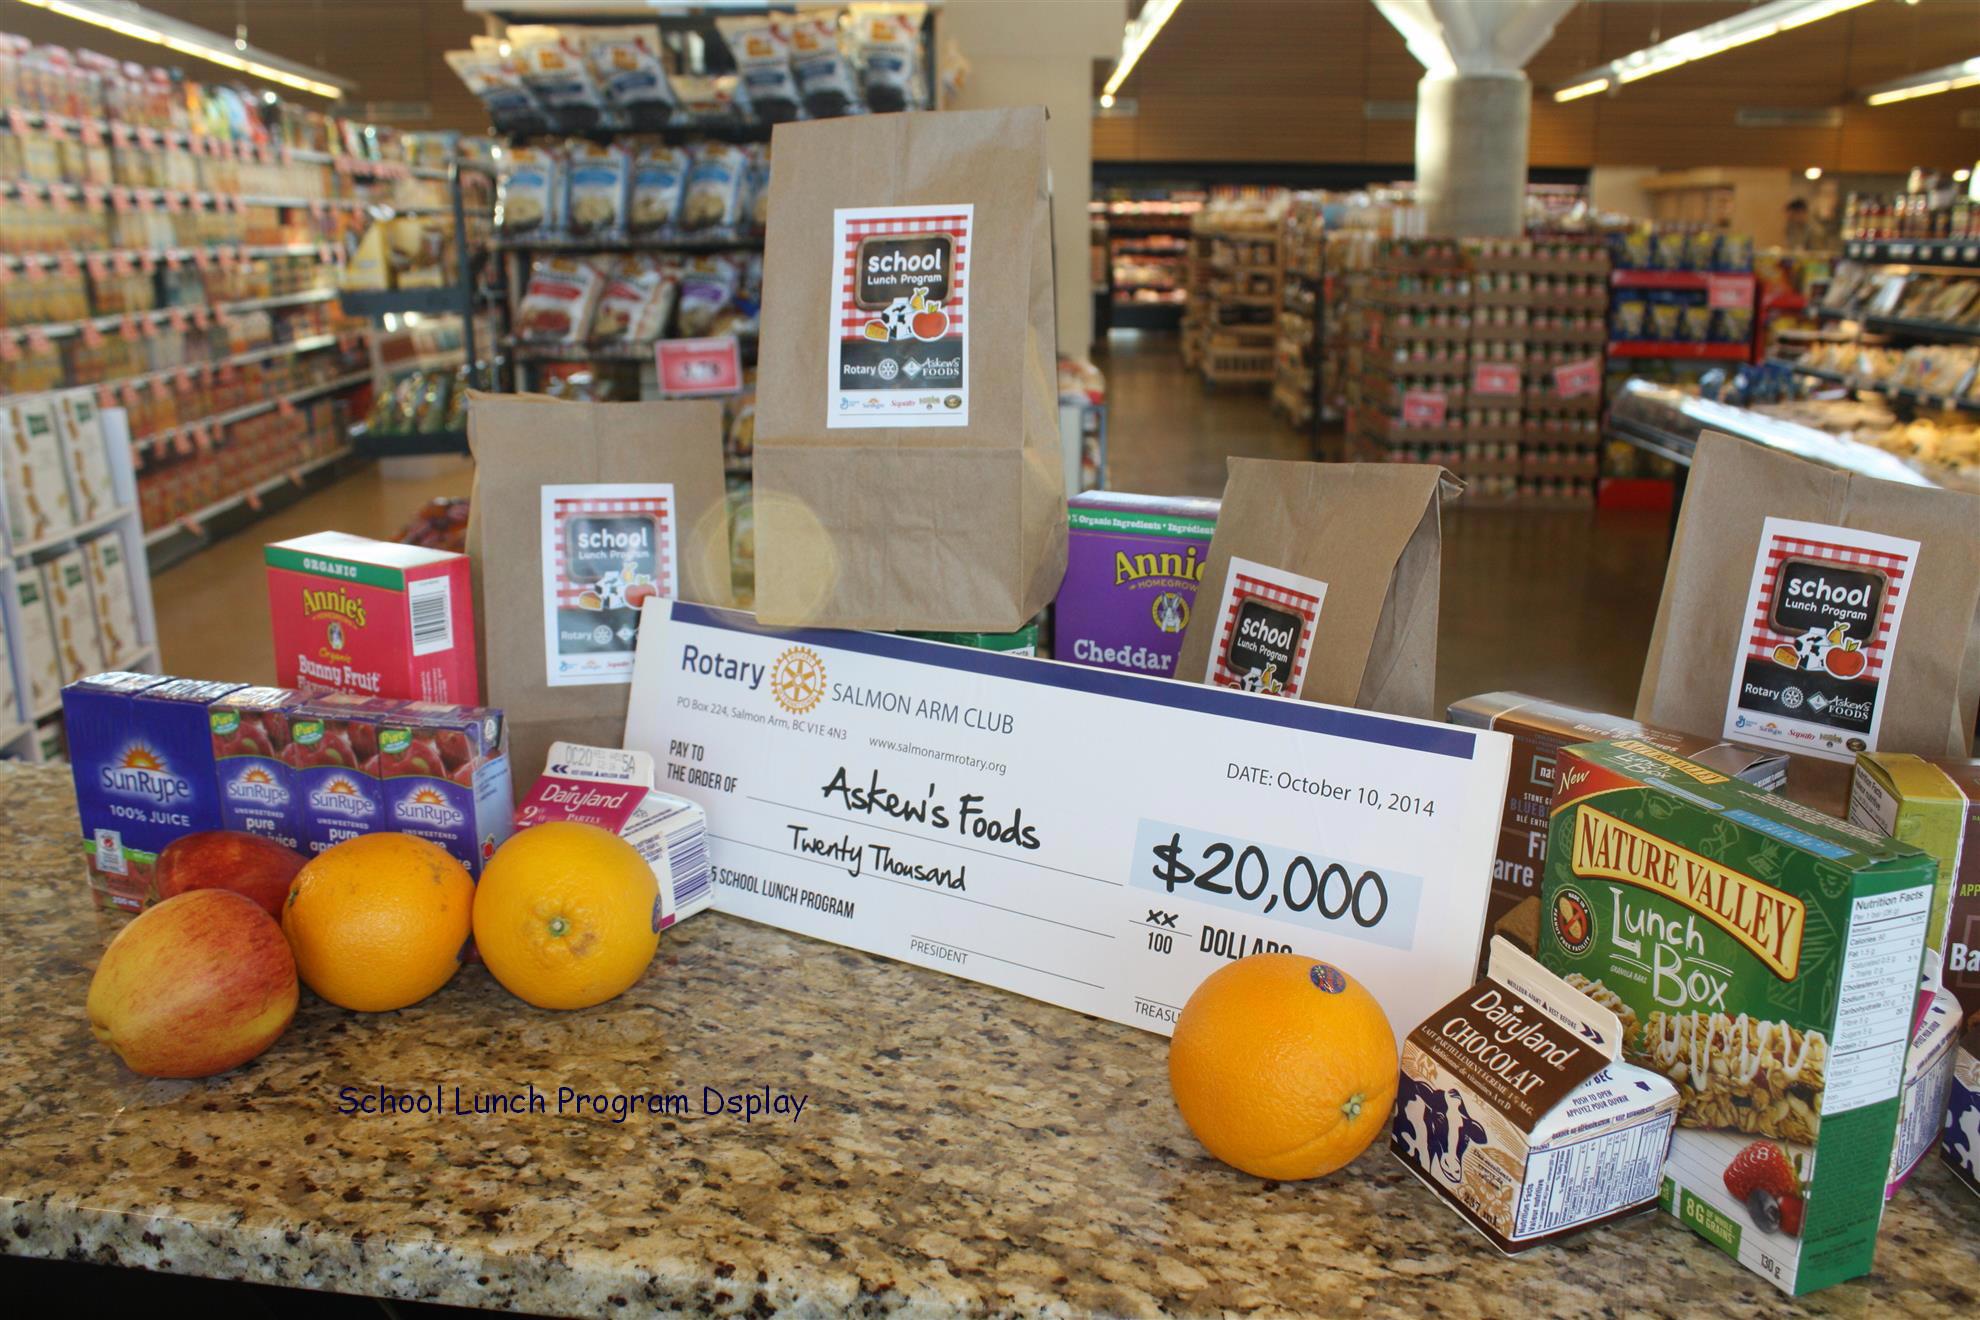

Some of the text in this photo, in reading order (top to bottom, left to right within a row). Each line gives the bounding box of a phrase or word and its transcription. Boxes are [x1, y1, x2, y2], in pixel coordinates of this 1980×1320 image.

[868, 248, 941, 273] school
[867, 273, 942, 286] Lunch Program
[843, 364, 876, 376] Rotary
[922, 367, 960, 376] FOODS
[1079, 515, 1112, 526] Organic
[1112, 517, 1162, 530] Ingredients
[578, 527, 648, 548] school
[303, 557, 358, 577] ORGANIC
[578, 550, 649, 562] Lunch Program
[1788, 577, 1871, 608] school
[303, 587, 367, 627] Annie's
[1785, 598, 1868, 621] Lunch Program
[561, 630, 592, 641] Rotary
[1241, 618, 1294, 650] school
[1073, 638, 1172, 671] Cheddar
[1237, 636, 1288, 664] Lunch Program
[298, 654, 342, 686] Bunny
[343, 665, 380, 692] Fruit
[681, 644, 765, 691] Rotary
[1744, 683, 1780, 700] Rotary
[677, 696, 848, 741] PO Box 224, Salmon Arm, BC V1E 4N3
[831, 683, 911, 715] SALMON
[915, 699, 959, 724] ARM
[964, 707, 1014, 734] CLUB
[1828, 705, 1869, 720] FOODS
[669, 739, 705, 762] PAY TO
[869, 736, 1007, 776] www.salmonarmrotary.org
[102, 767, 190, 802] SunRype
[667, 762, 738, 794] THE ORDER OF
[1226, 762, 1435, 817] DATE: October 10, 2014
[1557, 766, 1590, 795] New
[228, 783, 290, 804] SunRype
[311, 791, 375, 817] SunRype
[540, 784, 628, 812] Dairyland
[109, 804, 191, 828] 100% JUICE
[234, 807, 285, 818] UNSWEETENED
[397, 803, 464, 826] SunRype
[566, 813, 601, 824] PARTLY
[821, 766, 1041, 850] Askew's Foods
[1510, 797, 1551, 818] BLUEB
[246, 817, 275, 830] pure
[317, 818, 369, 830] UNSWEETENED
[1530, 817, 1549, 829] ENTIE
[786, 824, 967, 892] Twenty Thousand
[1528, 831, 1548, 861] Fi
[1152, 832, 1388, 928] $20,000
[1494, 858, 1534, 889] arre
[719, 868, 855, 920] SCHOOL LUNCH PROGRAM
[1577, 812, 1680, 891] NATURE
[1685, 858, 1798, 965] VALLEY
[1856, 890, 1924, 911] Nutrition Facts
[1960, 884, 1980, 897] APP
[1608, 886, 1704, 959] Lunch
[911, 939, 968, 965] PRESIDENT
[1148, 931, 1173, 955] 100
[1571, 936, 1591, 952] FACILITY
[1949, 942, 1980, 972] Ba
[1652, 942, 1729, 1012] Box
[1134, 1000, 1181, 1024] TREASU
[1470, 989, 1580, 1068] Dairyland
[1421, 1025, 1437, 1039] LAIT
[1435, 1036, 1483, 1075] PARTIELLEMENT
[1441, 1017, 1545, 1096] CHOCOLAT
[1566, 1095, 1630, 1118] APPUYEZ POUR OUVRIR
[1572, 1089, 1613, 1106] PUSH TO OPEN
[1518, 1183, 1534, 1233] Nutrition Facts
[1528, 1179, 1544, 1232] Valeur nutritive
[1686, 1198, 1704, 1225] 8G
[1705, 1219, 1733, 1245] GRAINS
[1760, 1253, 1781, 1280] 130 g
